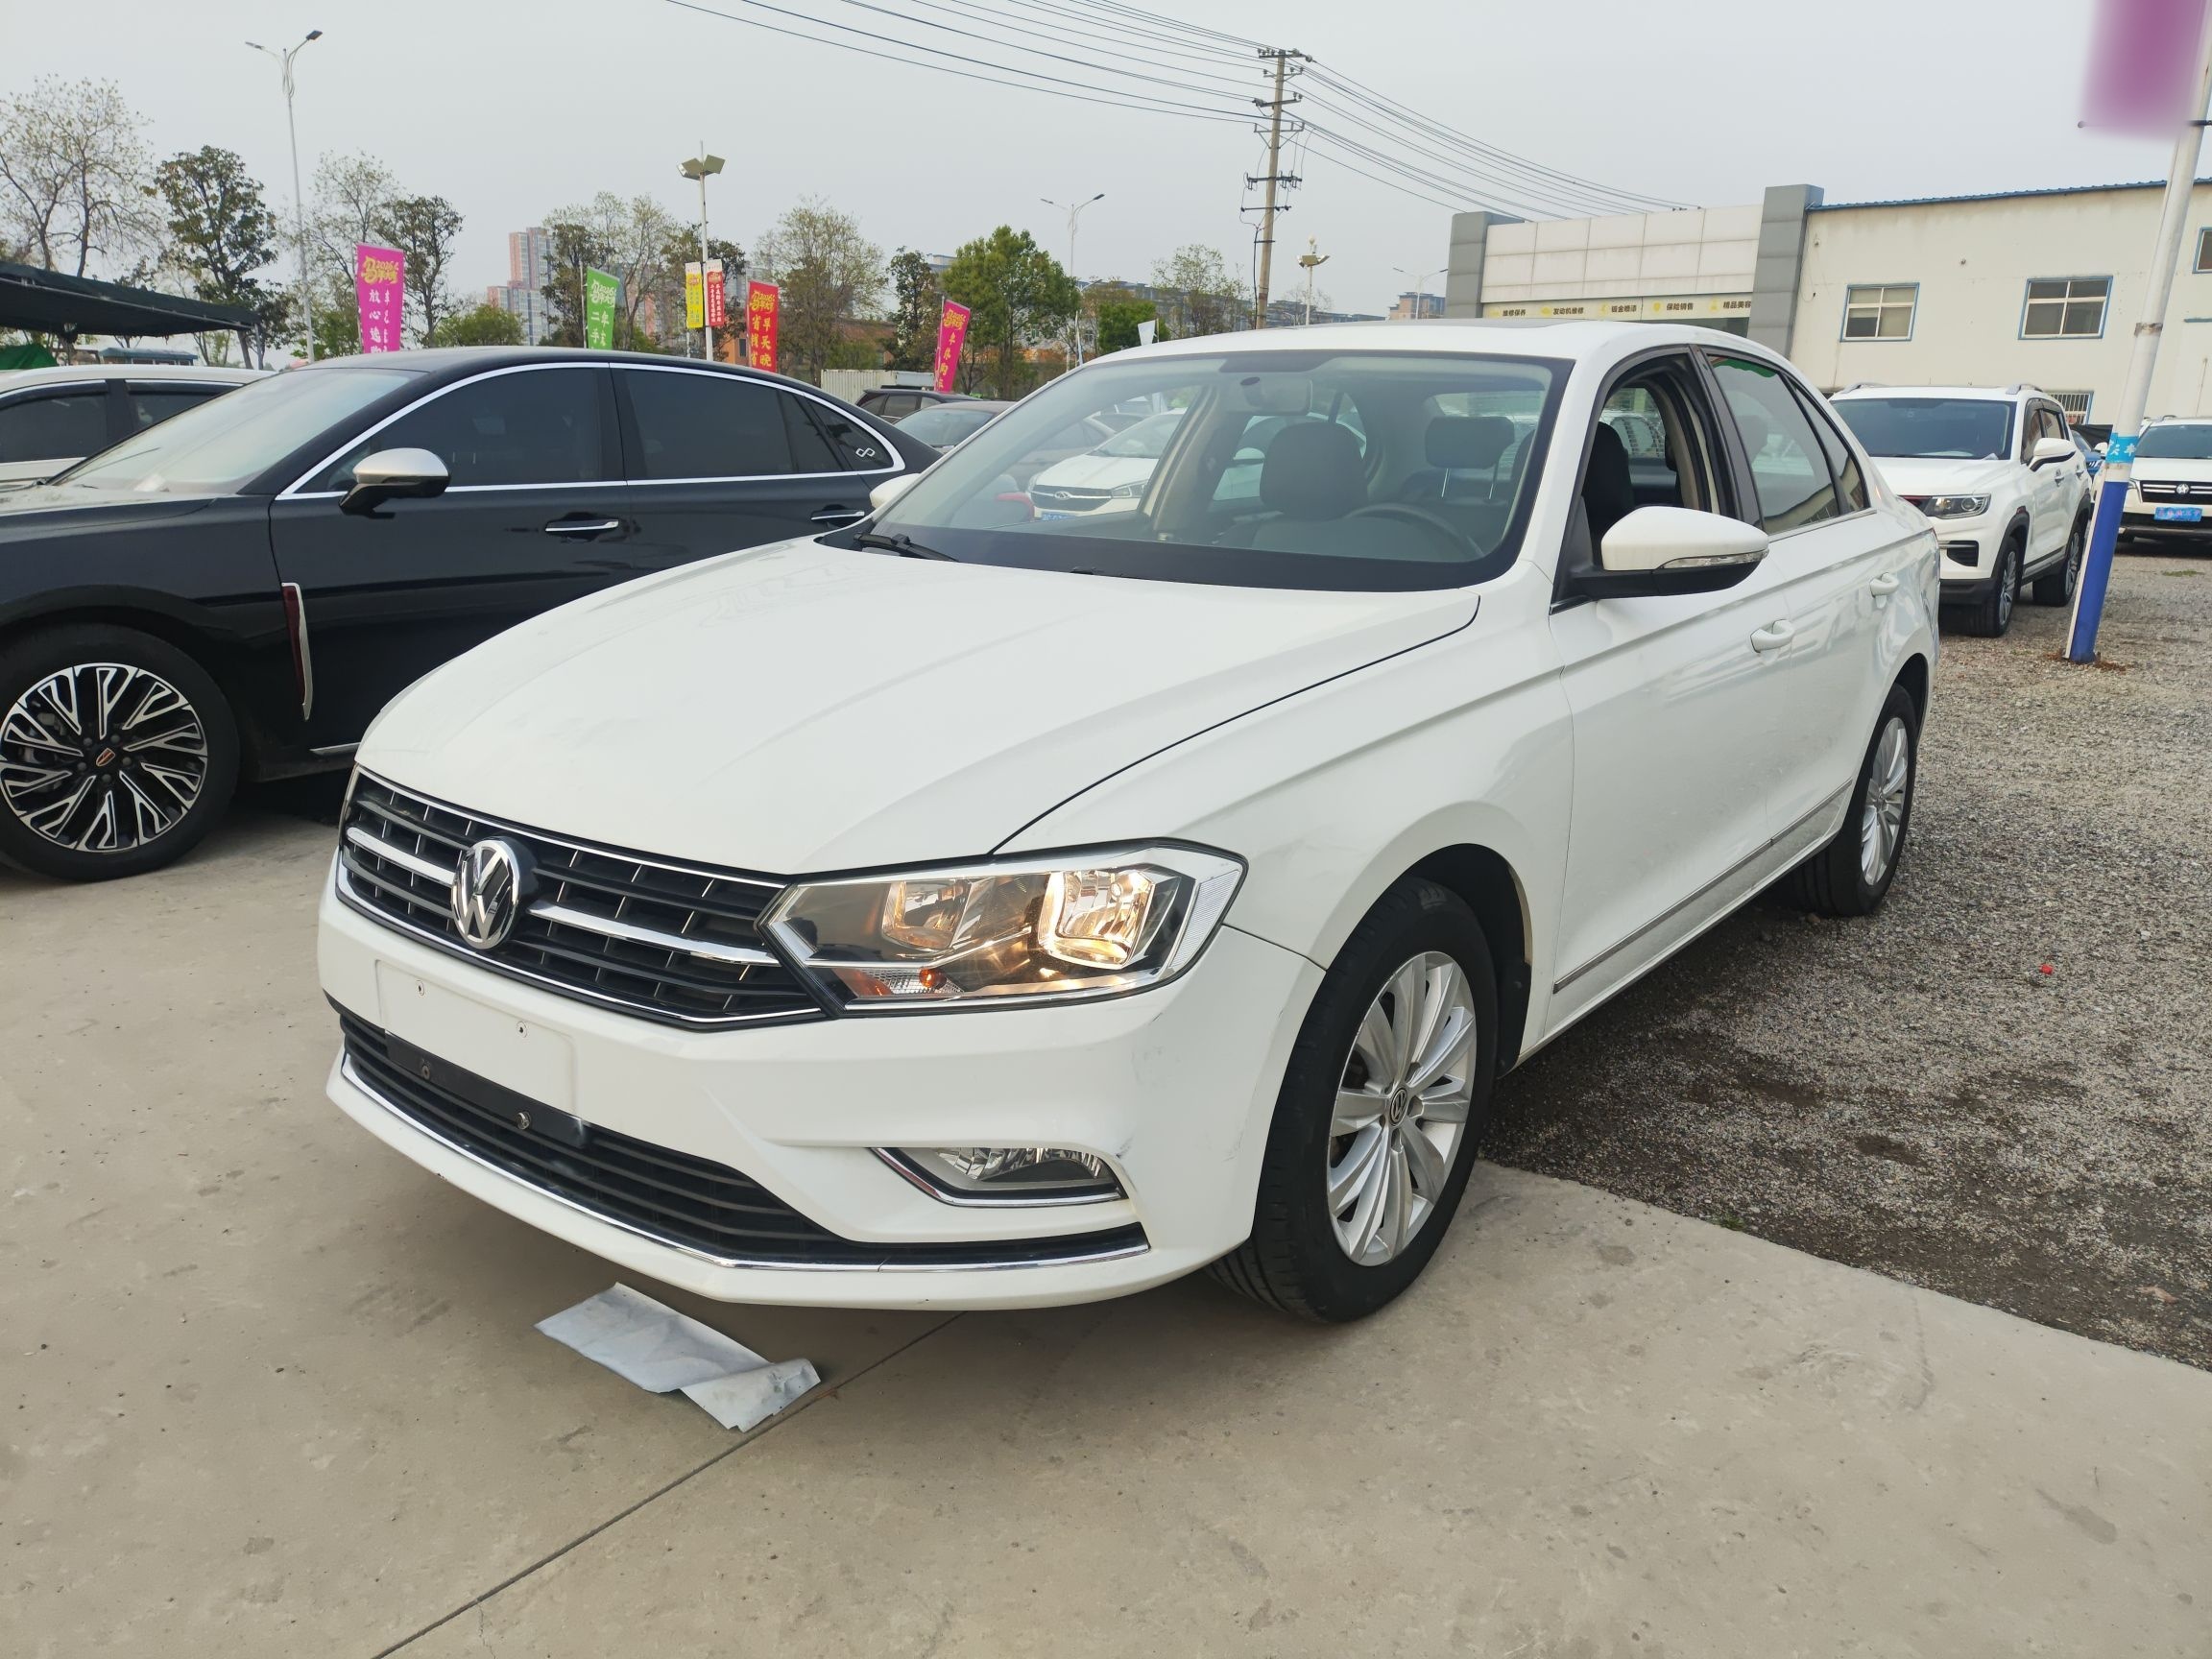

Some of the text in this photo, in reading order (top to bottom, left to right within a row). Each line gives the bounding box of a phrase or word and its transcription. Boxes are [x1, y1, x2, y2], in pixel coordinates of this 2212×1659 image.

[1611, 304, 1637, 313] 钣金喷漆
[1666, 302, 1694, 311] 保险销售
[1722, 301, 1751, 309] 精品美容
